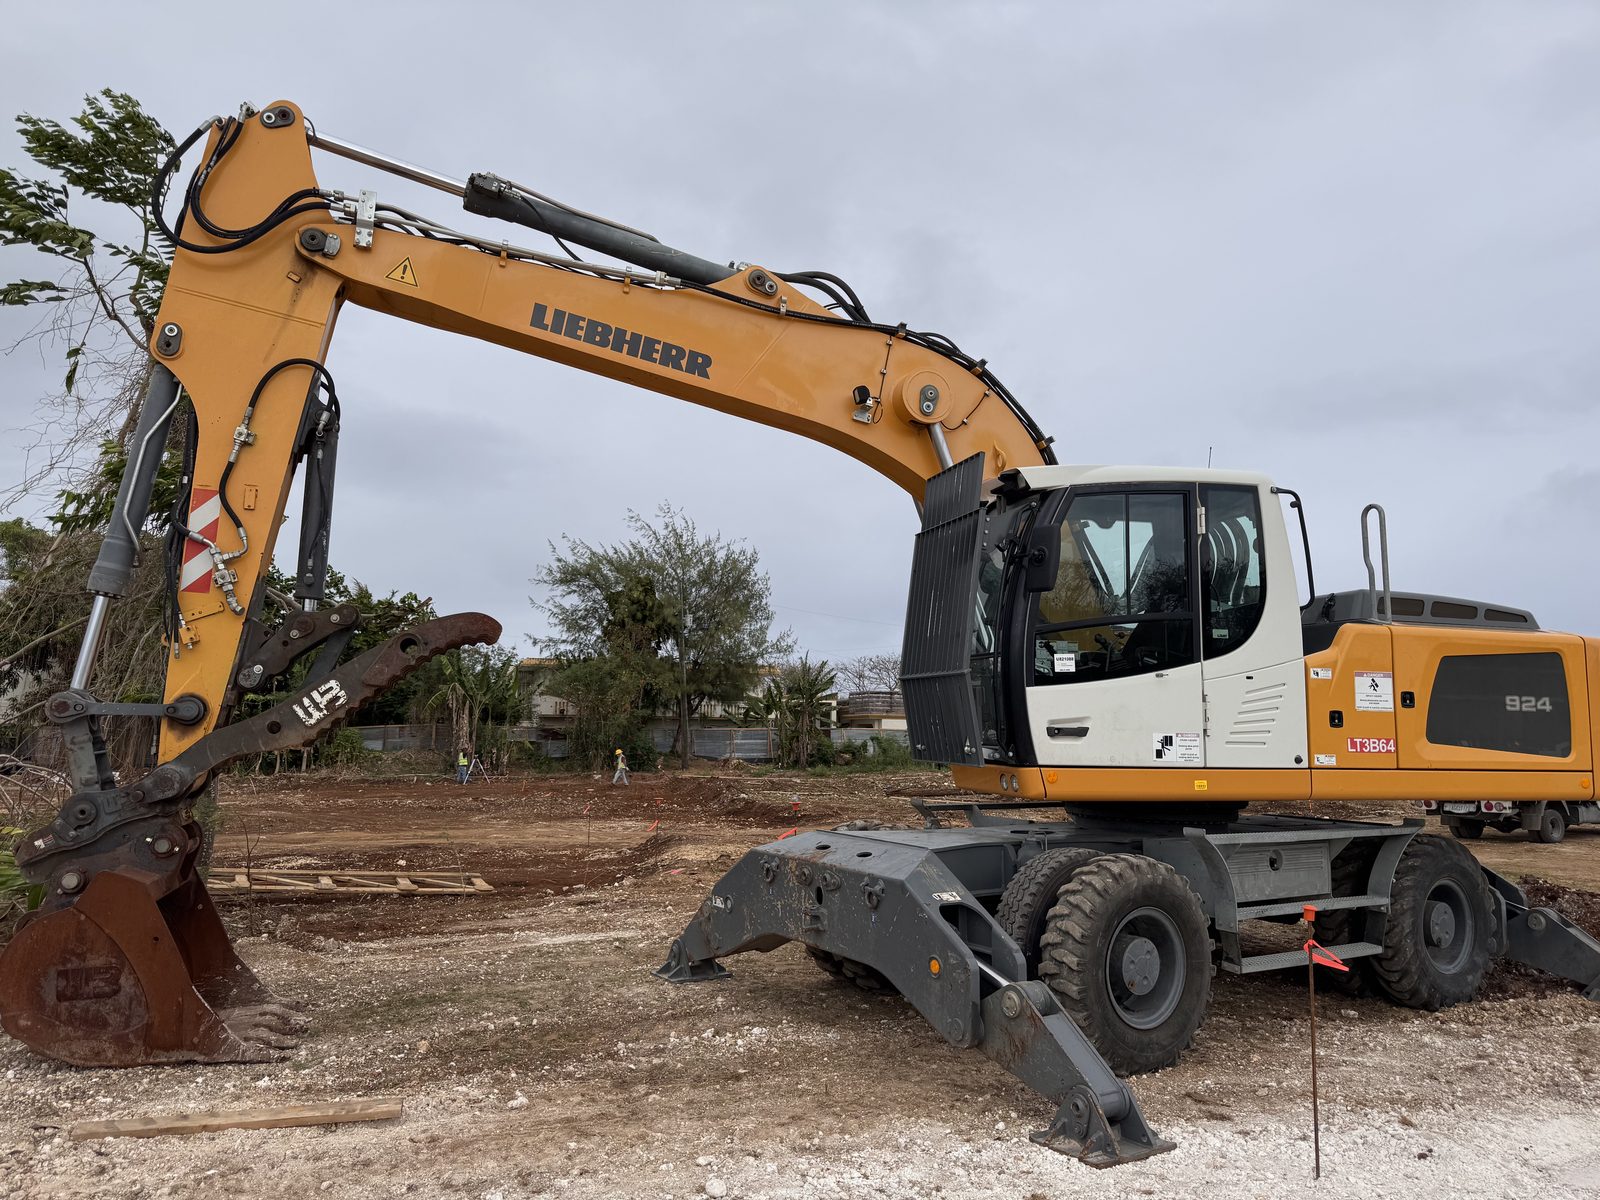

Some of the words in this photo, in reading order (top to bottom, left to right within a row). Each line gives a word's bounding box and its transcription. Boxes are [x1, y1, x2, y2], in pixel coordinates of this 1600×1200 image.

[530, 302, 713, 380] LIEBHERR
[1505, 695, 1552, 712] 924
[1347, 738, 1395, 753] LT3B64
